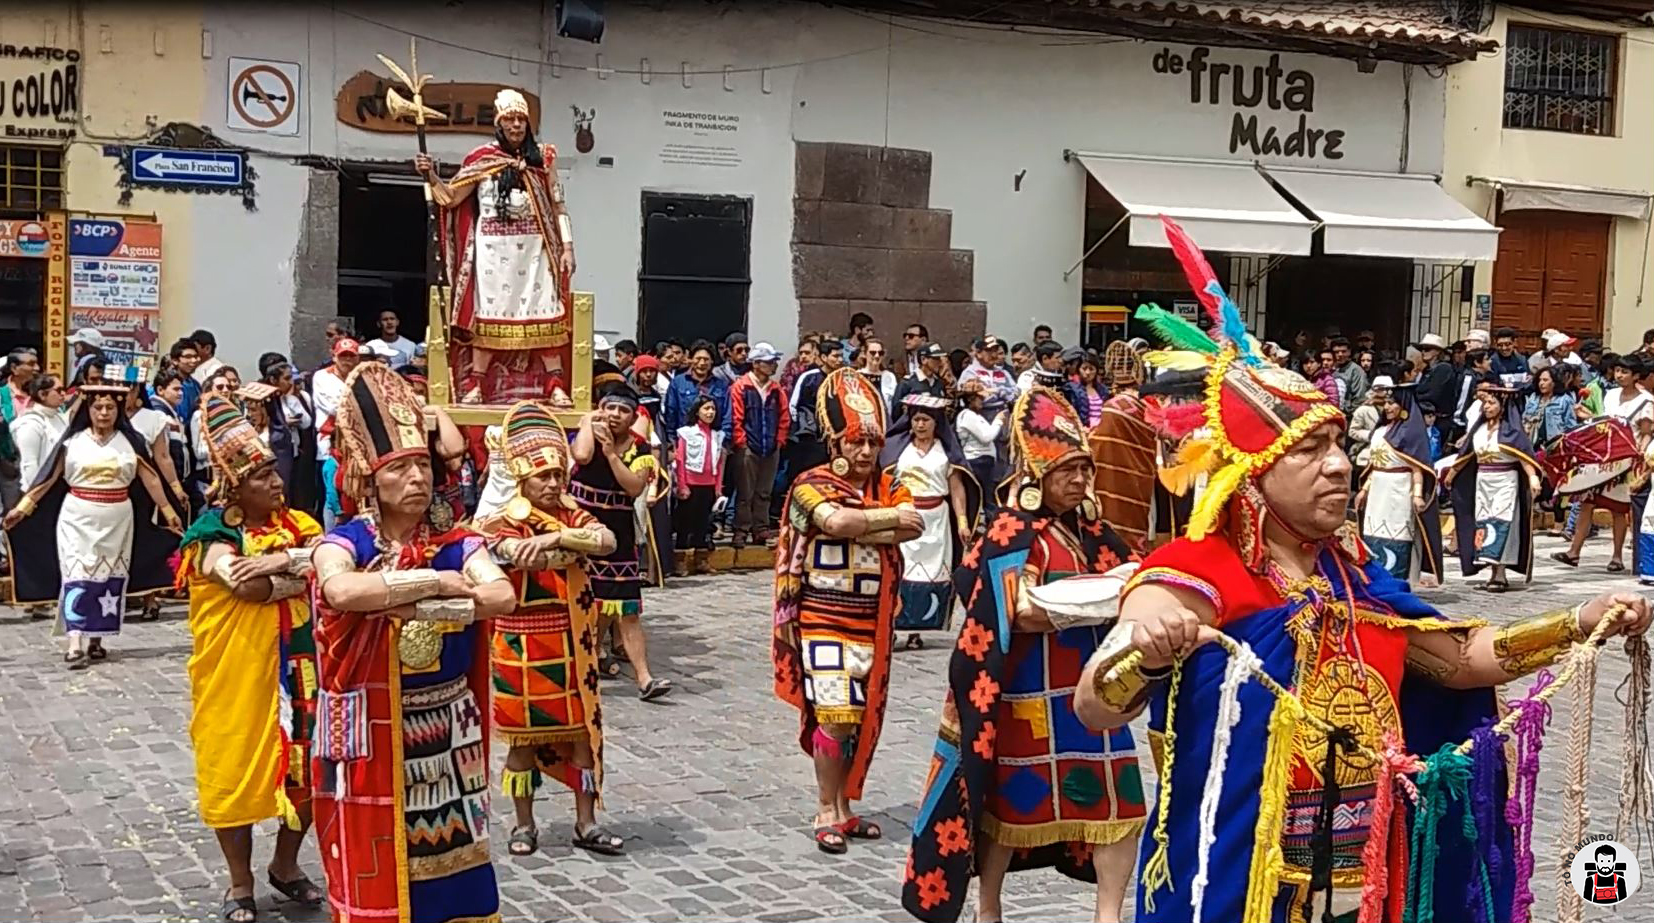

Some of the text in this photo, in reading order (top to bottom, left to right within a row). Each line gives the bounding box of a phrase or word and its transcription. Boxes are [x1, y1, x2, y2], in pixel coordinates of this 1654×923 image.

[0, 44, 80, 62] RAFICO
[1152, 47, 1314, 113] de fruta
[12, 64, 77, 118] COLOR
[663, 111, 707, 120] FRAGMENTO
[5, 124, 77, 139] Express
[683, 121, 693, 129] DE
[1229, 112, 1346, 160] Madre
[171, 160, 189, 171] San
[191, 161, 234, 174] Francisco
[81, 223, 111, 237] BCP
[119, 244, 160, 257] Agente
[50, 275, 63, 348] REGALOS
[1178, 305, 1196, 314] VISA
